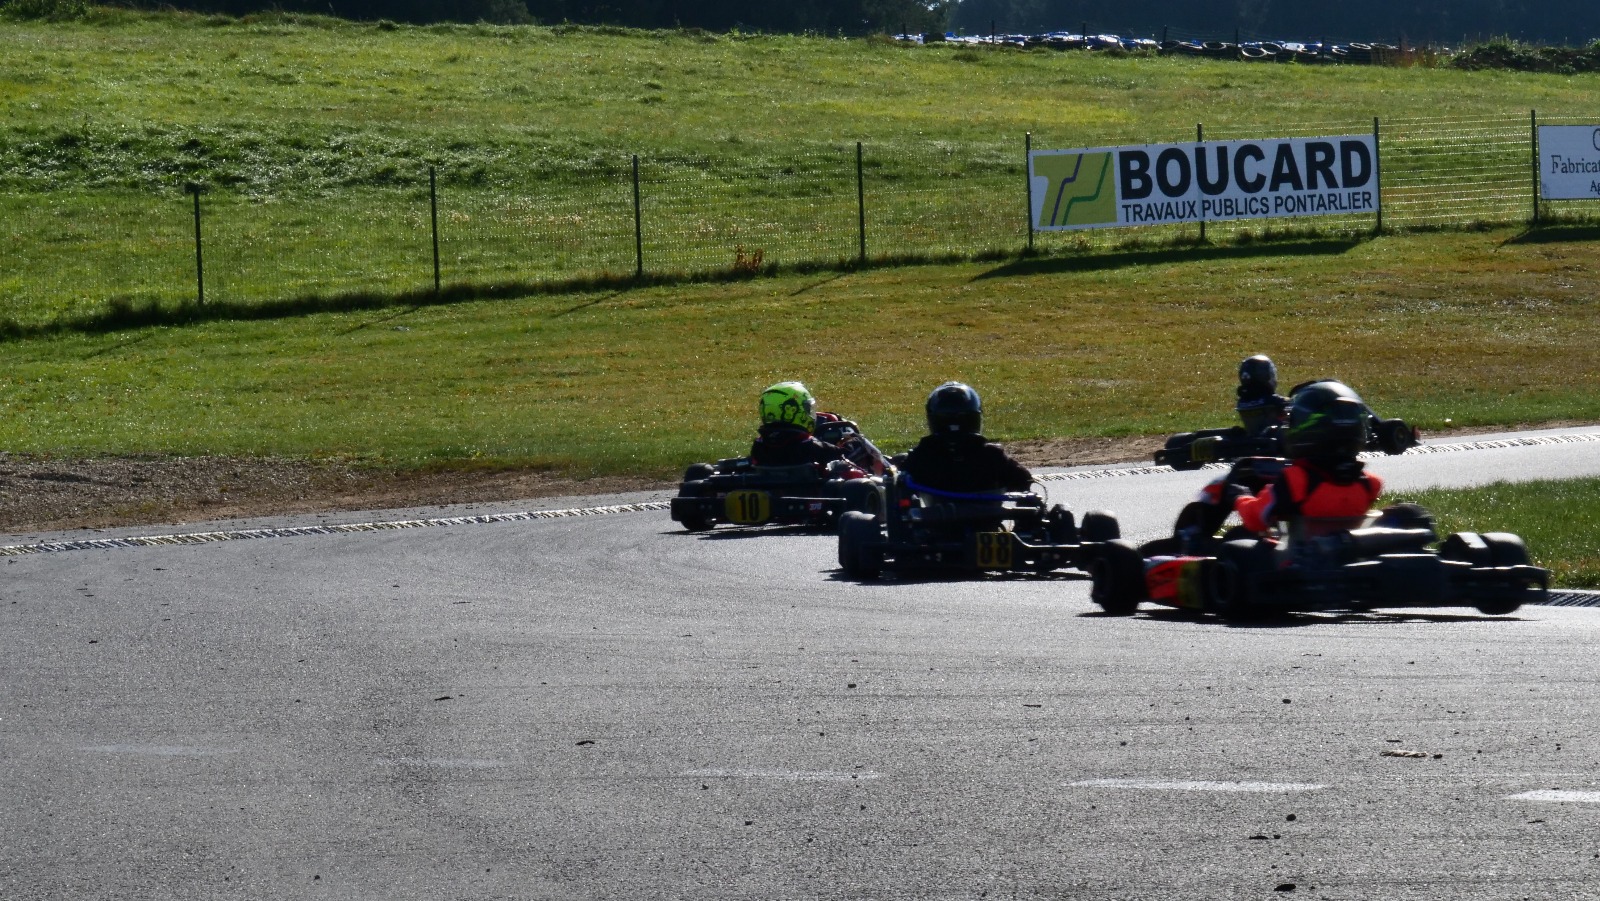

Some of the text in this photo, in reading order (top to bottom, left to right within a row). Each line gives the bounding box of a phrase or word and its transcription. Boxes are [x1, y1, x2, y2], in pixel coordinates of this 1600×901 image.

[1119, 140, 1372, 200] BOUCARD
[1121, 191, 1373, 222] TRAVAUX PUBLICS PONTARLIER
[738, 493, 760, 521] 10
[980, 533, 1010, 565] 88
